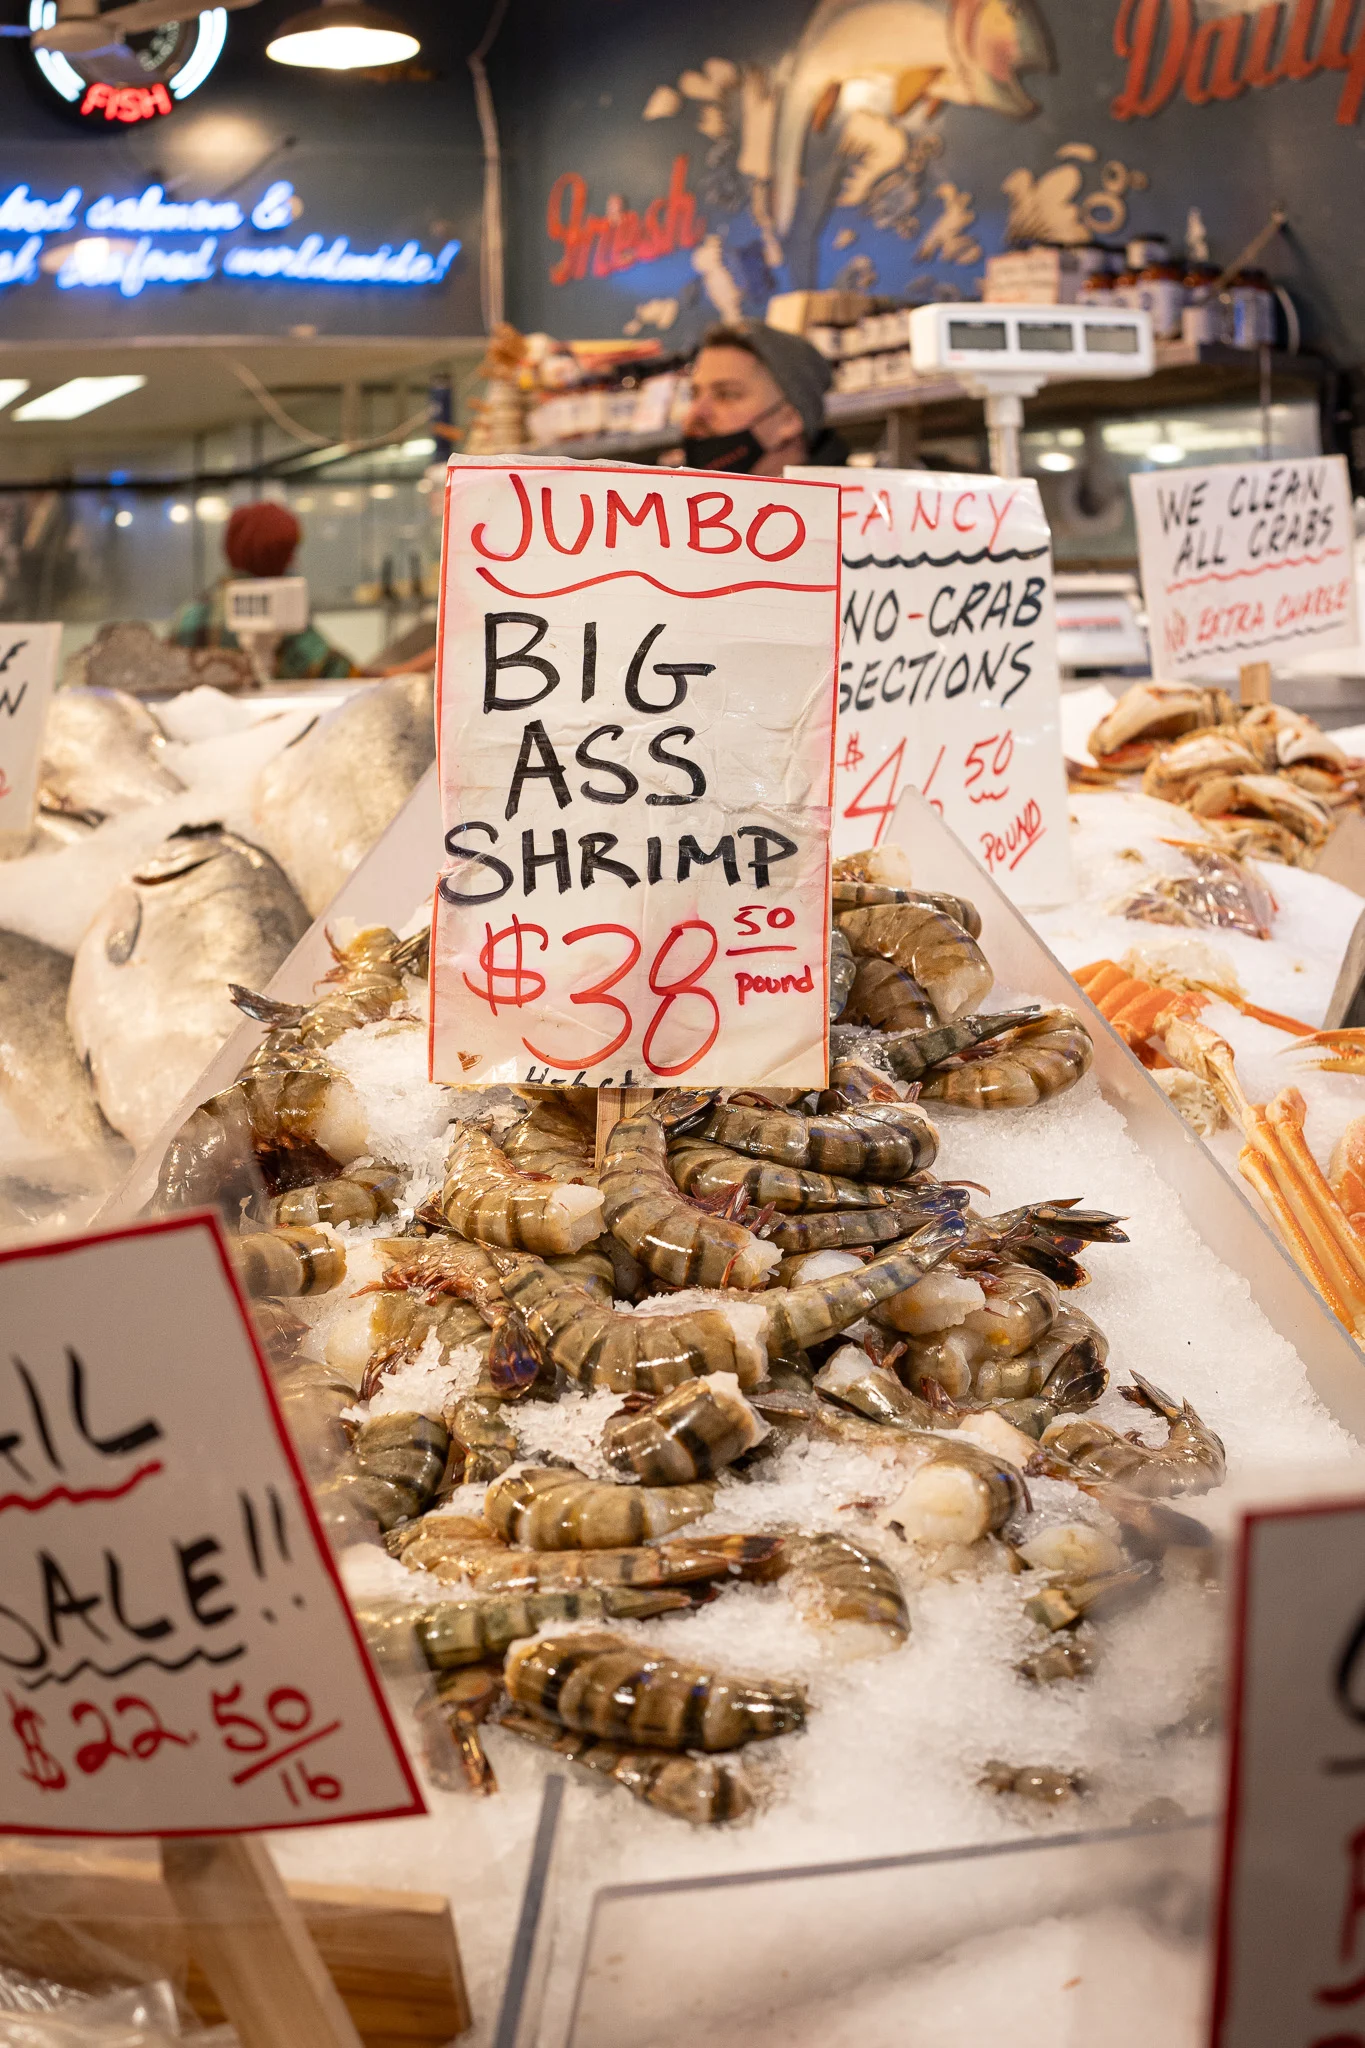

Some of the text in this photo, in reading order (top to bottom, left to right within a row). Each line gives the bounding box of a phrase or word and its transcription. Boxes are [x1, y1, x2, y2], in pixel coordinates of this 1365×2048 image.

[80, 82, 172, 122] FISH
[85, 184, 244, 232] salmon
[251, 180, 296, 231] &
[471, 474, 806, 561] JUMBO
[841, 486, 1020, 552] FANCY
[1157, 465, 1327, 534] WE CLEAN
[1173, 504, 1334, 576] ALL CRABS
[483, 612, 716, 714] BIG
[839, 641, 1035, 714] SECTIONS
[505, 719, 706, 820] ASS
[964, 729, 1013, 788] 50
[439, 821, 798, 906] SHRIMP
[980, 798, 1041, 874] POUND
[463, 905, 795, 1076] $38 50
[735, 965, 815, 1005] pound
